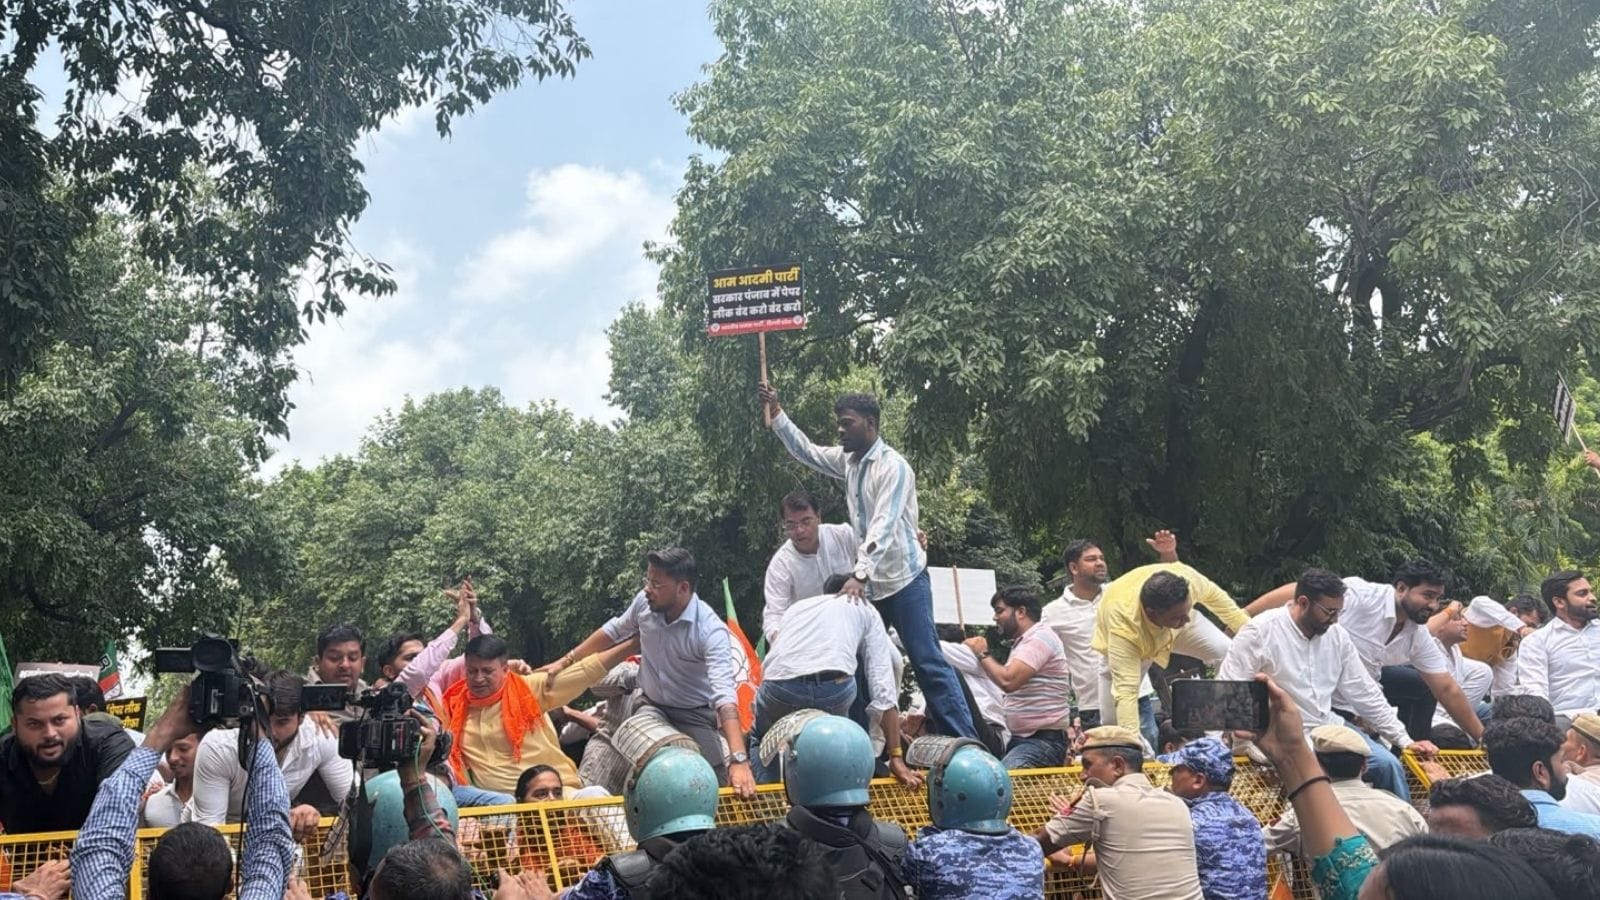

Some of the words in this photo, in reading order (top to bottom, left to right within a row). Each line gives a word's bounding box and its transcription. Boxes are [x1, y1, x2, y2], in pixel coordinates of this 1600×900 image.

[714, 277, 737, 288] आम
[739, 270, 773, 286] आदमी
[775, 267, 800, 281] पार्टी
[712, 292, 743, 303] सरकार
[744, 289, 770, 299] पंजाब
[770, 285, 780, 298] में
[782, 286, 800, 296] पेपर
[712, 306, 733, 318] लीक
[735, 304, 748, 316] बंद
[749, 302, 767, 315] करो
[768, 301, 781, 313] बंद
[783, 299, 801, 312] करो
